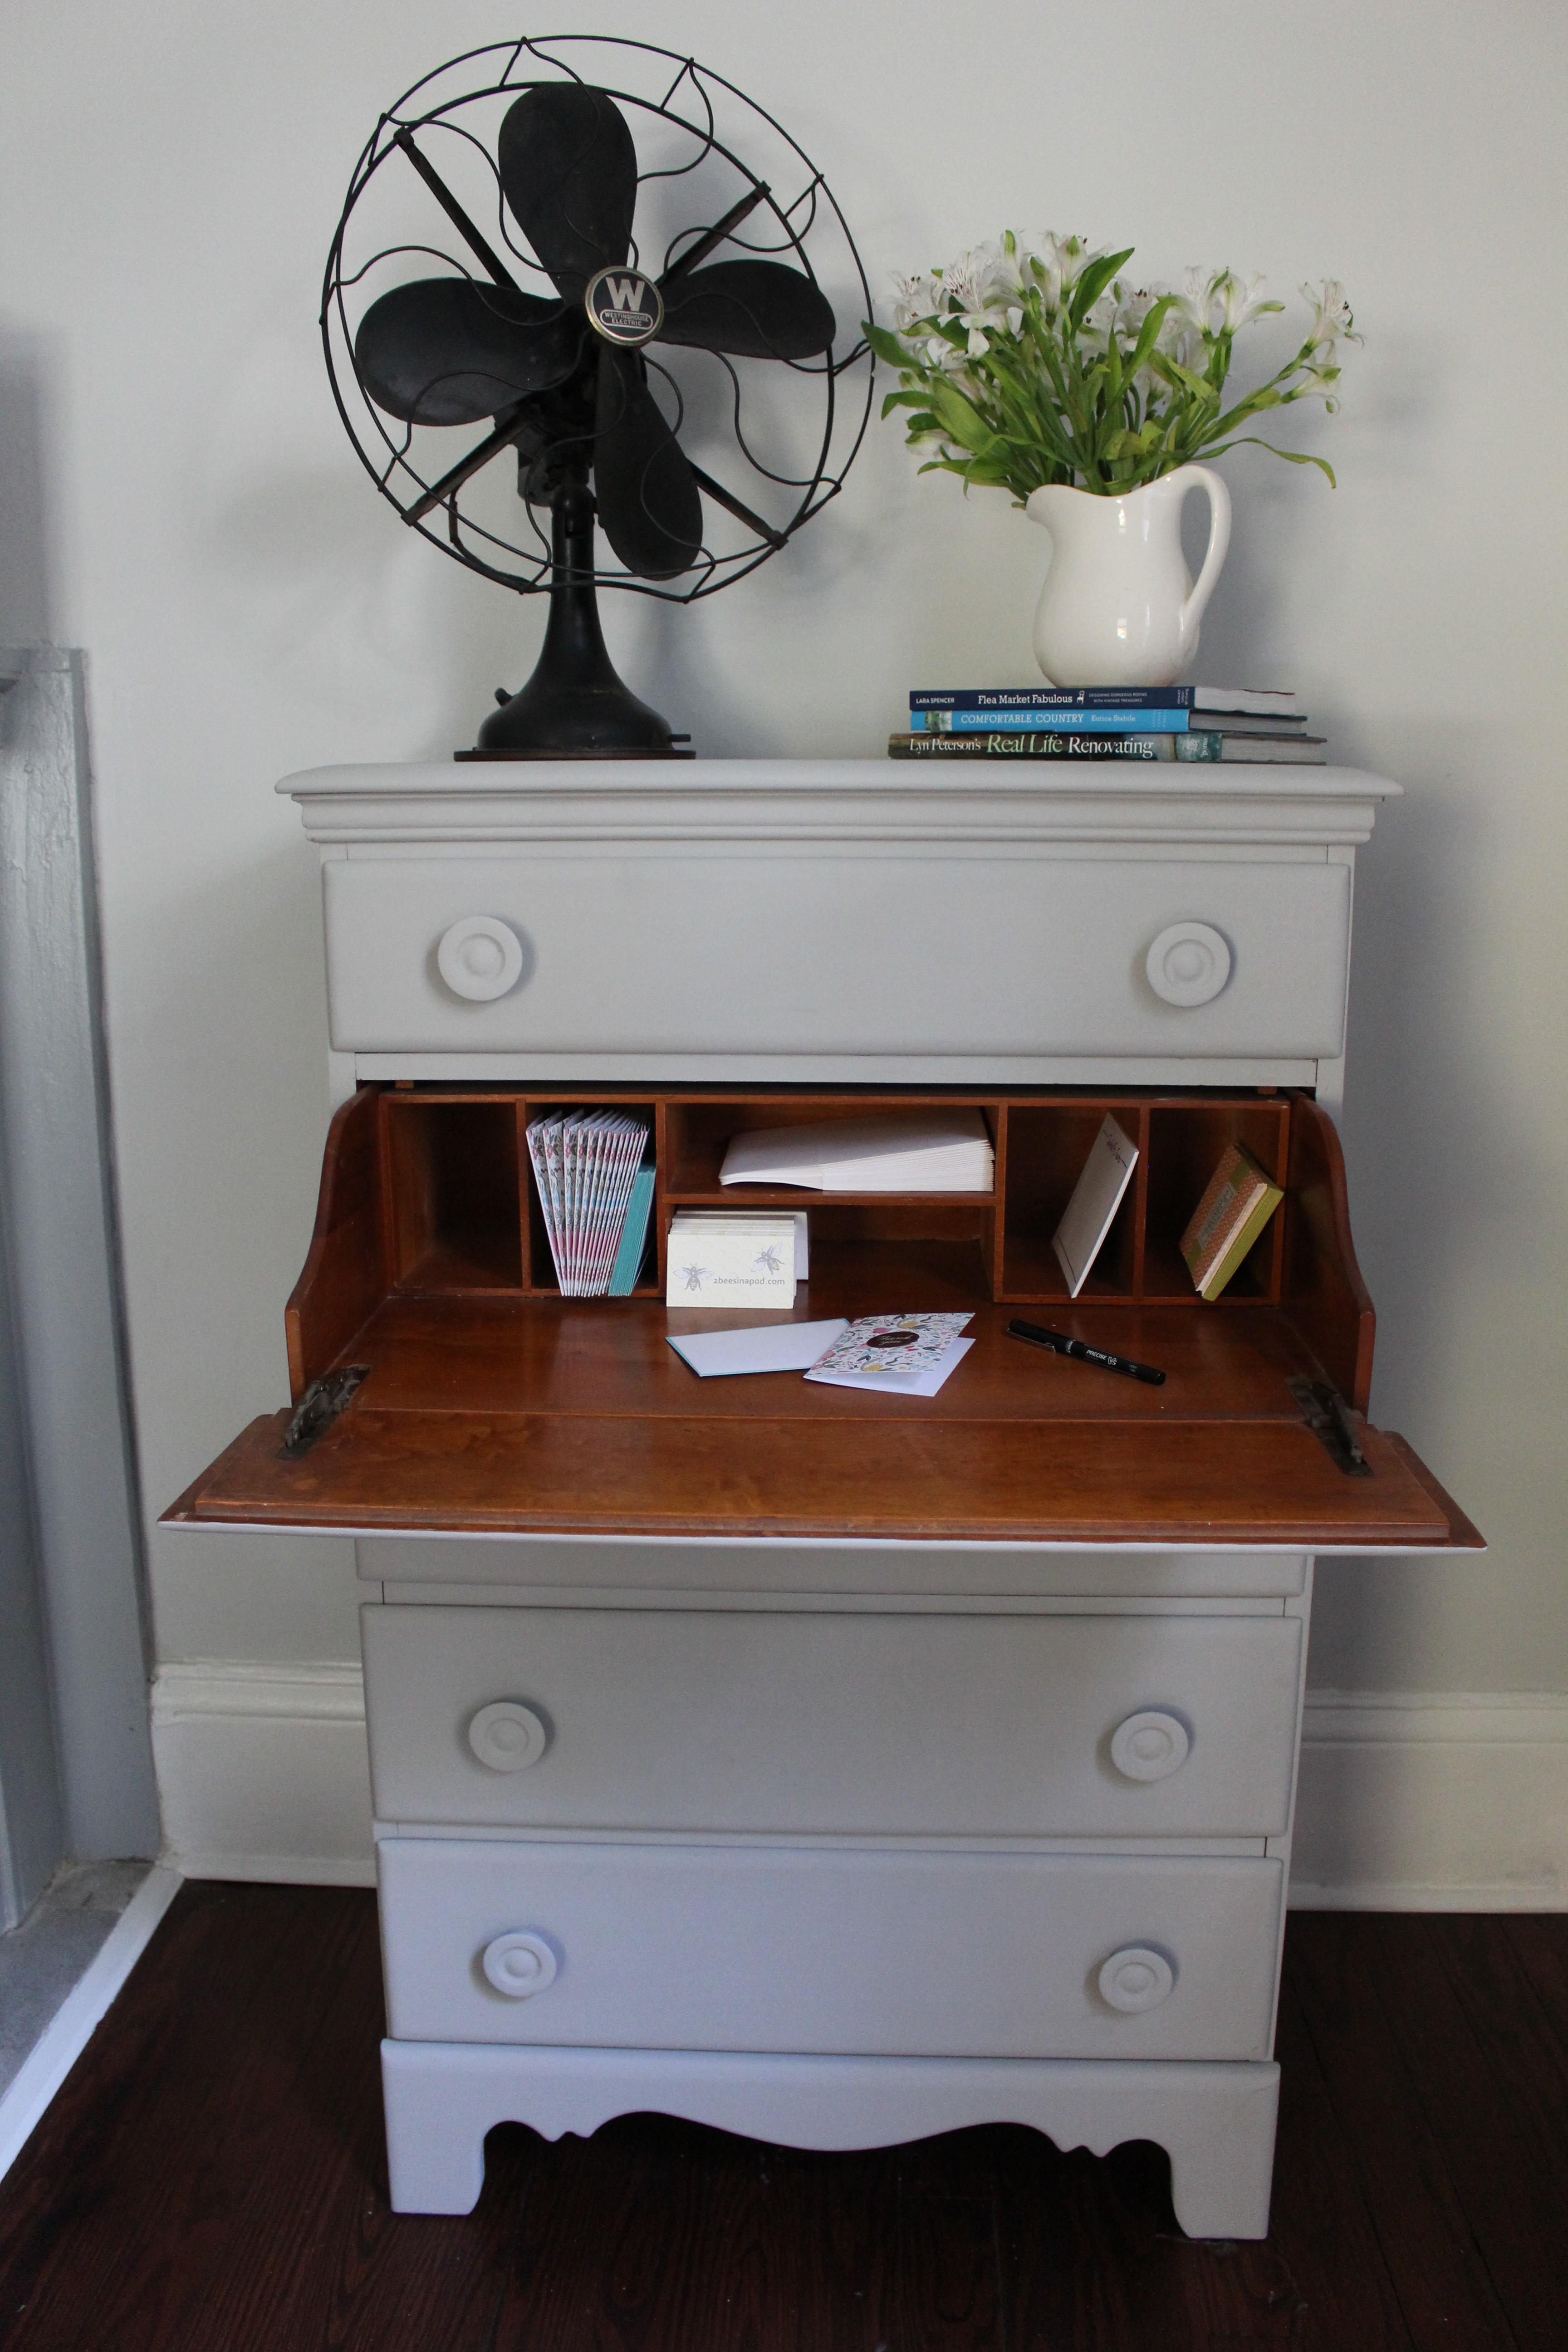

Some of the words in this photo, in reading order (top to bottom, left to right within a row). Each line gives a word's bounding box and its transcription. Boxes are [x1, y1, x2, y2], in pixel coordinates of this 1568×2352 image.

[605, 276, 645, 312] W
[604, 311, 649, 322] WESTINGHOUSE
[611, 318, 642, 327] ELECTRIC
[978, 695, 997, 705] Flea
[999, 694, 1030, 704] Market
[1032, 694, 1073, 703] Fabulous
[960, 714, 1032, 724] COMFORTABLE
[1035, 713, 1084, 723] COUNTRY
[909, 738, 929, 754] Lyn
[931, 737, 981, 752] Peterson's
[986, 734, 1025, 753] Real
[1028, 734, 1063, 753] Life
[1068, 736, 1154, 759] Renovating
[713, 1276, 785, 1286] 2beesinapod.com
[1086, 1349, 1107, 1360] PRECISE
